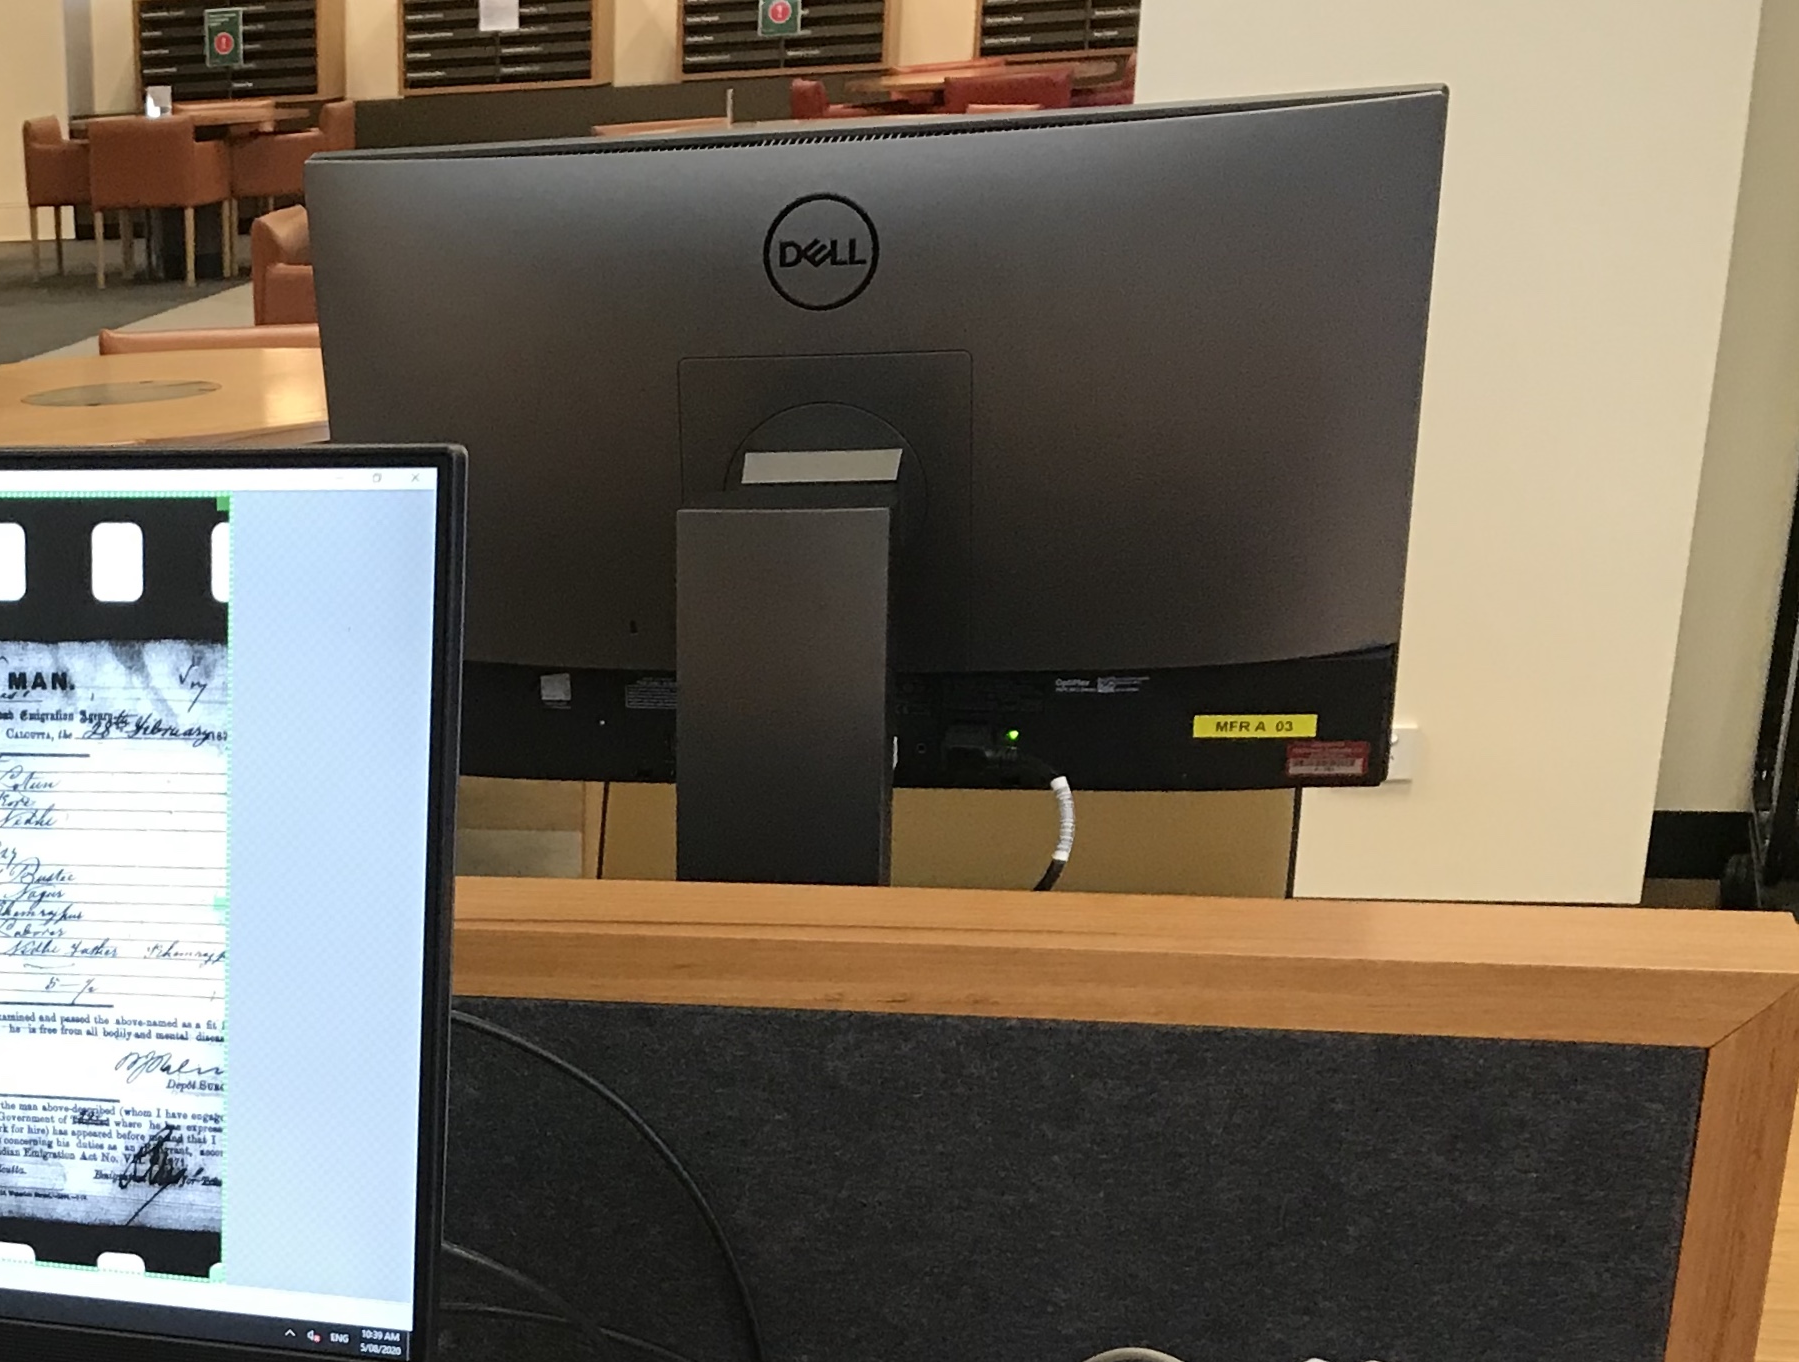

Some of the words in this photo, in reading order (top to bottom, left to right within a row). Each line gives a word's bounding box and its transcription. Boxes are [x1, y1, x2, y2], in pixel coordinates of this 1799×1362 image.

[779, 238, 867, 267] DELL
[8, 672, 75, 690] MAN.
[19, 708, 74, 723] Emigration
[1215, 721, 1251, 732] MFR
[1254, 721, 1266, 732] A
[1275, 720, 1294, 732] 03
[6, 728, 54, 742] CALCUTTA,
[58, 729, 73, 740] the
[39, 1013, 57, 1023] and
[60, 1014, 91, 1025] passed
[94, 1015, 110, 1025] the
[115, 1016, 178, 1028] above-named
[182, 1021, 193, 1029] as
[206, 1020, 217, 1030] fit
[9, 1024, 21, 1033] he
[29, 1025, 37, 1034] is
[39, 1024, 57, 1034] free
[61, 1025, 83, 1035] from
[86, 1026, 98, 1037] all
[103, 1027, 131, 1040] bodily
[134, 1028, 152, 1039] and
[156, 1030, 189, 1041] mental
[330, 1332, 349, 1343] ENG
[361, 1329, 383, 1341] 10:39
[384, 1331, 401, 1342] AM
[360, 1342, 402, 1356] 5/08/2020
